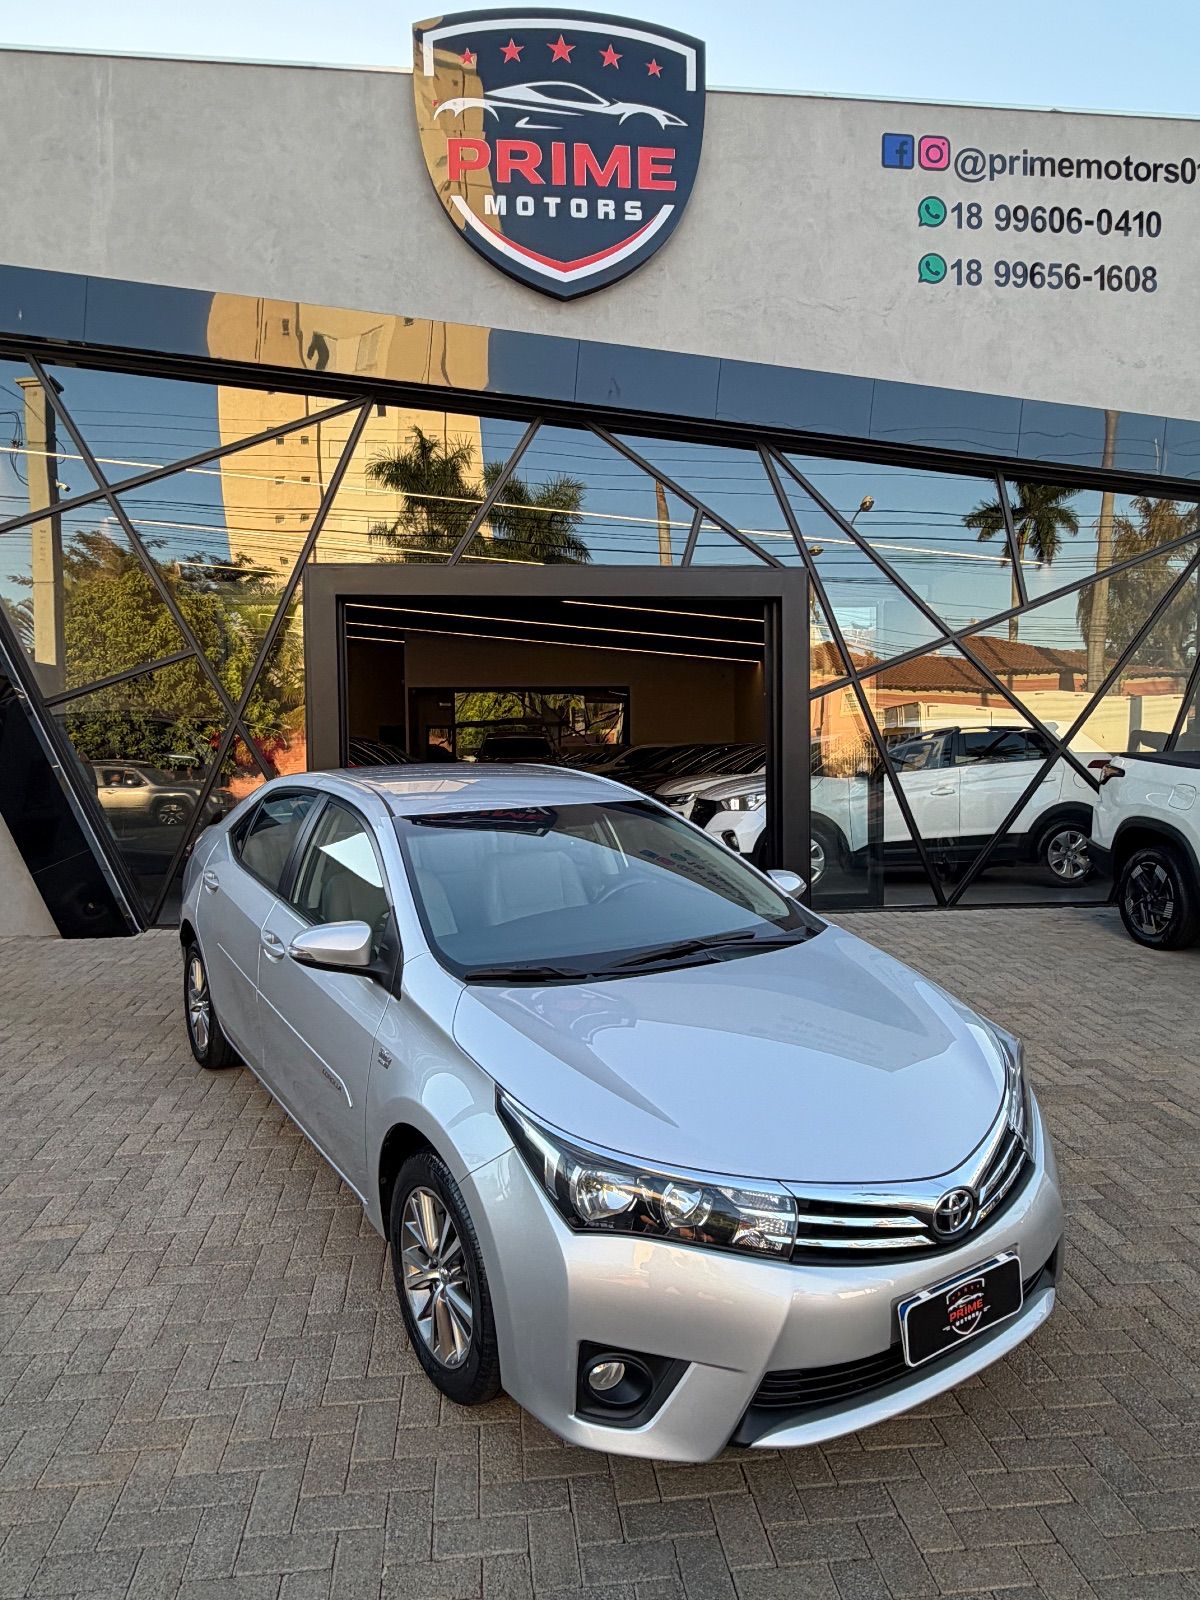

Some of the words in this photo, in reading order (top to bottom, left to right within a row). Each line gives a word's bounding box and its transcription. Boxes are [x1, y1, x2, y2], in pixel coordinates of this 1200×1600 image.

[446, 137, 677, 191] PRIME
[484, 194, 643, 221] MOTORS
[950, 202, 983, 230] 18
[994, 204, 1162, 238] 99606-0410
[950, 258, 983, 286] 18
[994, 260, 1158, 293] 99656-1608
[949, 1299, 984, 1323] PRIME
